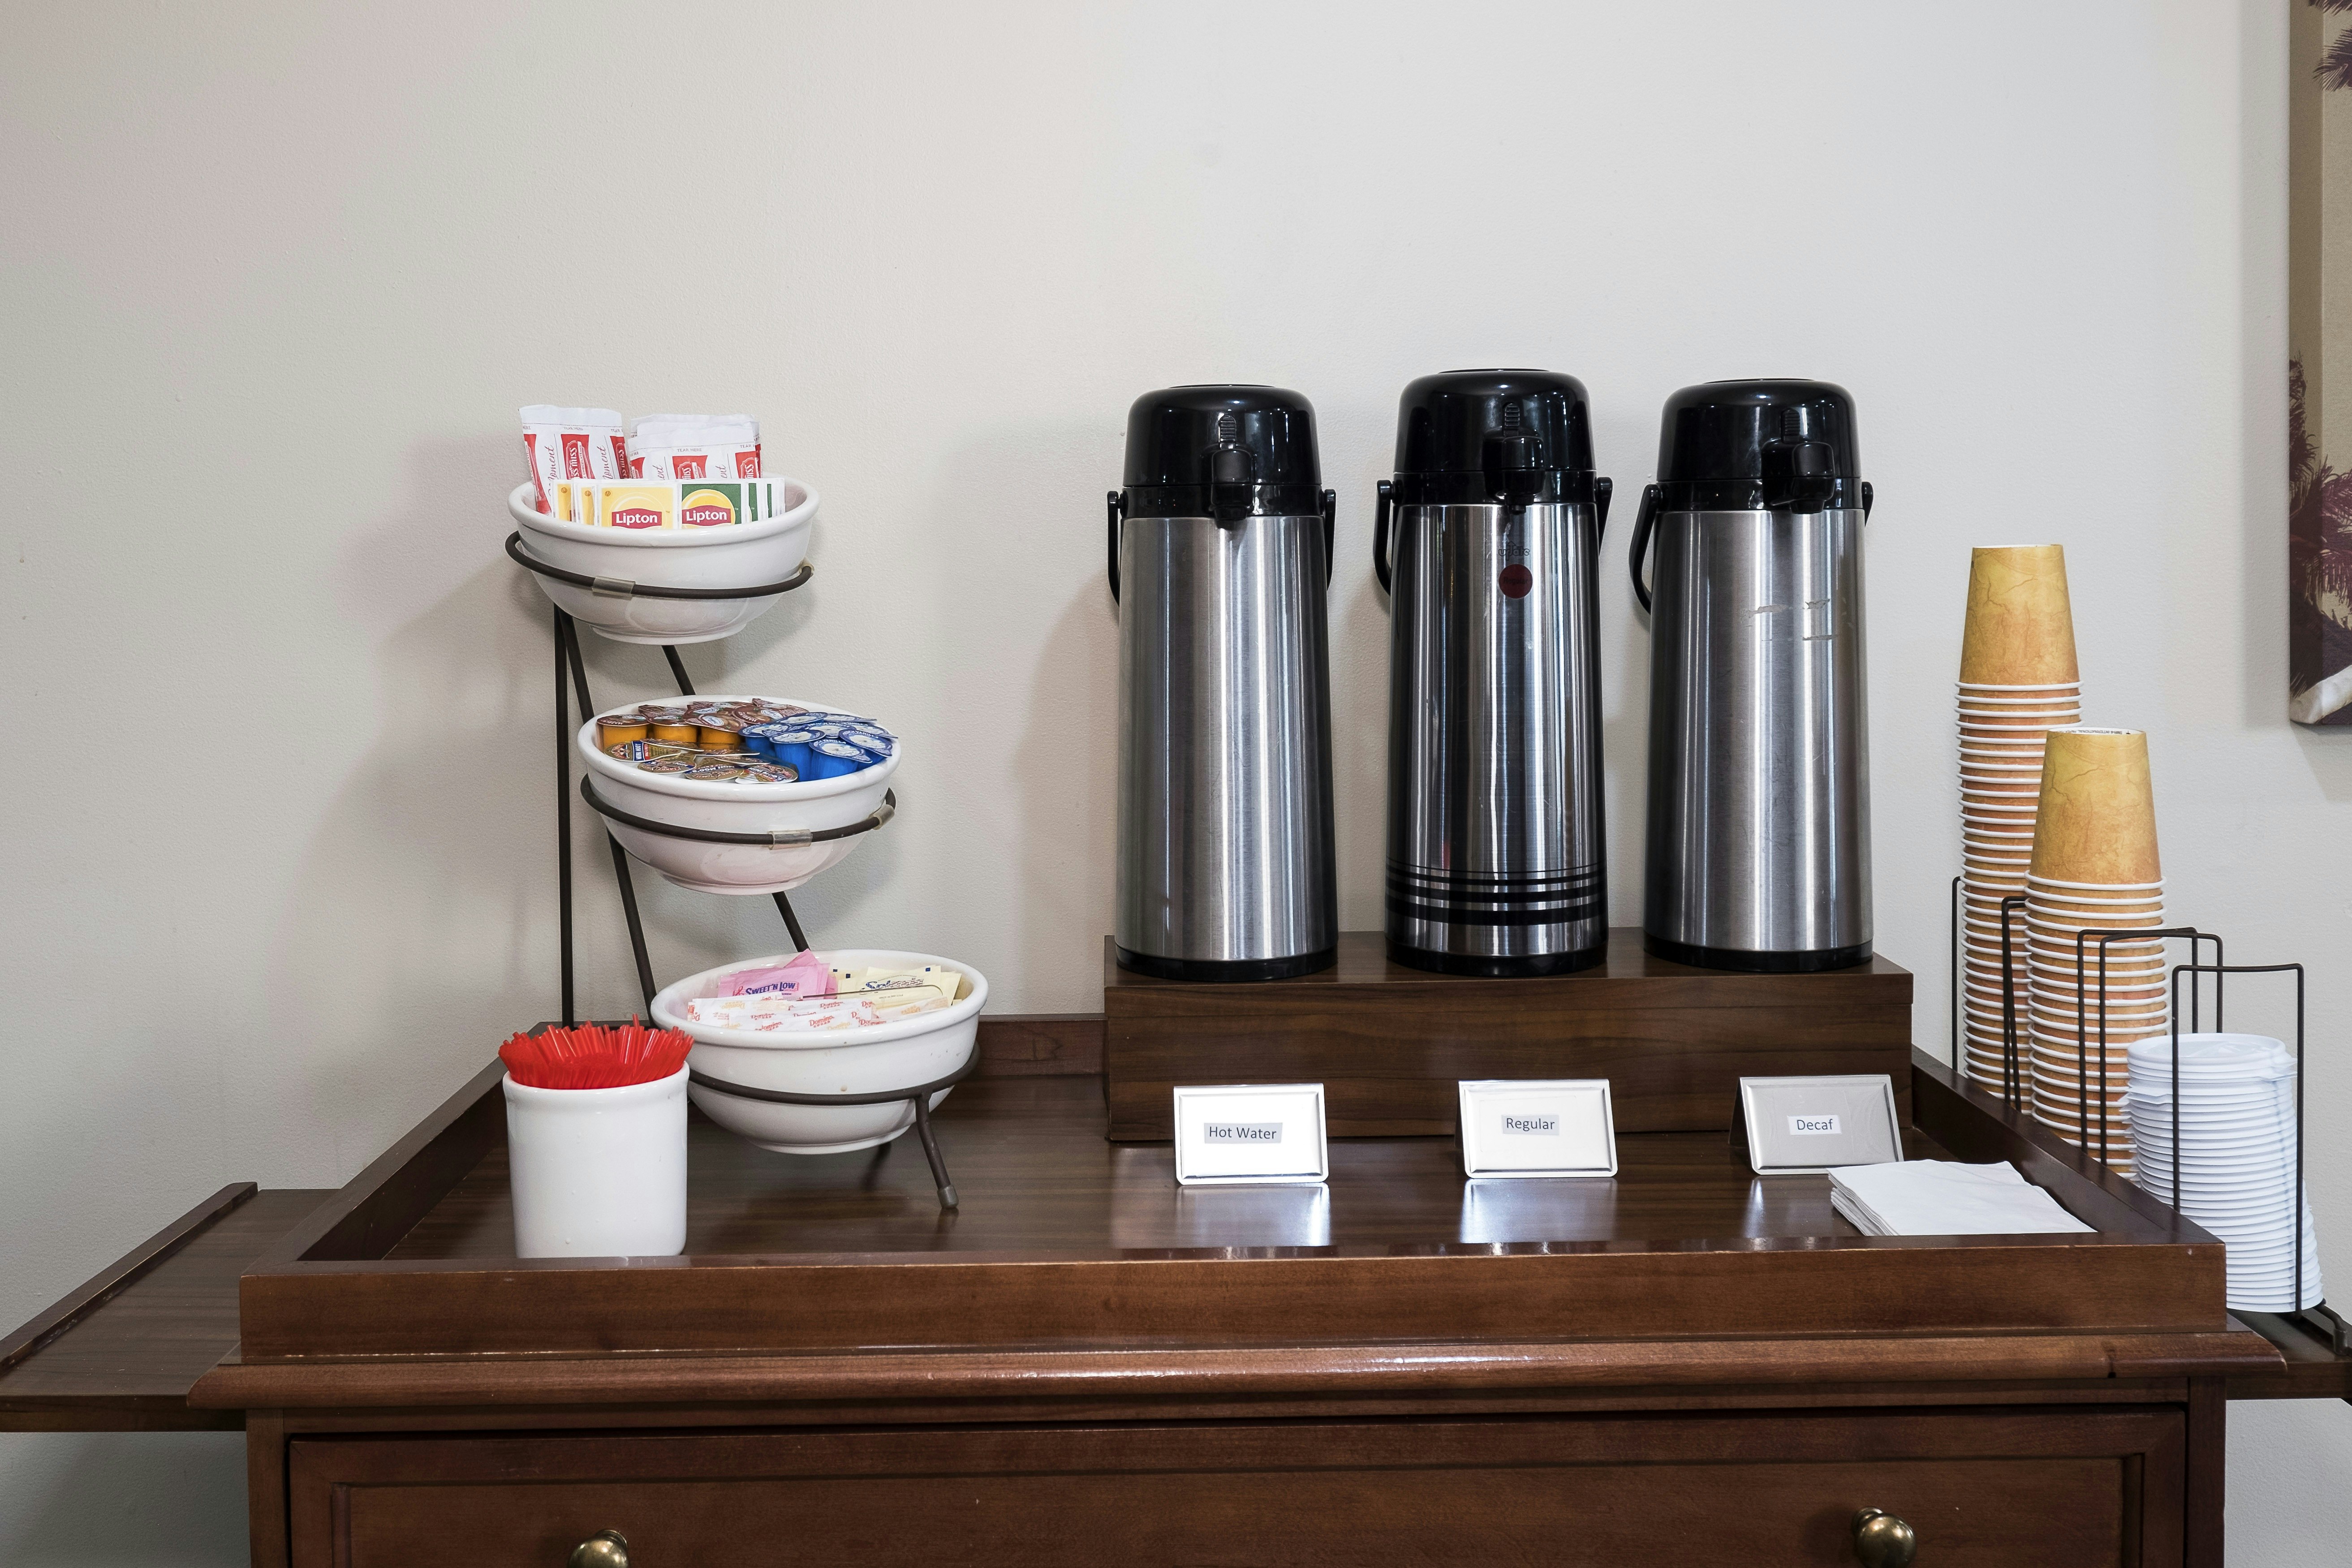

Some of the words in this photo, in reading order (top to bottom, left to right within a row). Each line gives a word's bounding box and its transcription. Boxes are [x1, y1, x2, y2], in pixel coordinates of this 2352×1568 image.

[616, 513, 658, 526] Lipton
[686, 510, 727, 523] Lipton
[810, 1015, 835, 1026] Domino
[1507, 1118, 1555, 1132] Regular
[1797, 1119, 1833, 1130] Decaf
[1210, 1126, 1232, 1138] Hot
[1236, 1127, 1277, 1139] Water
